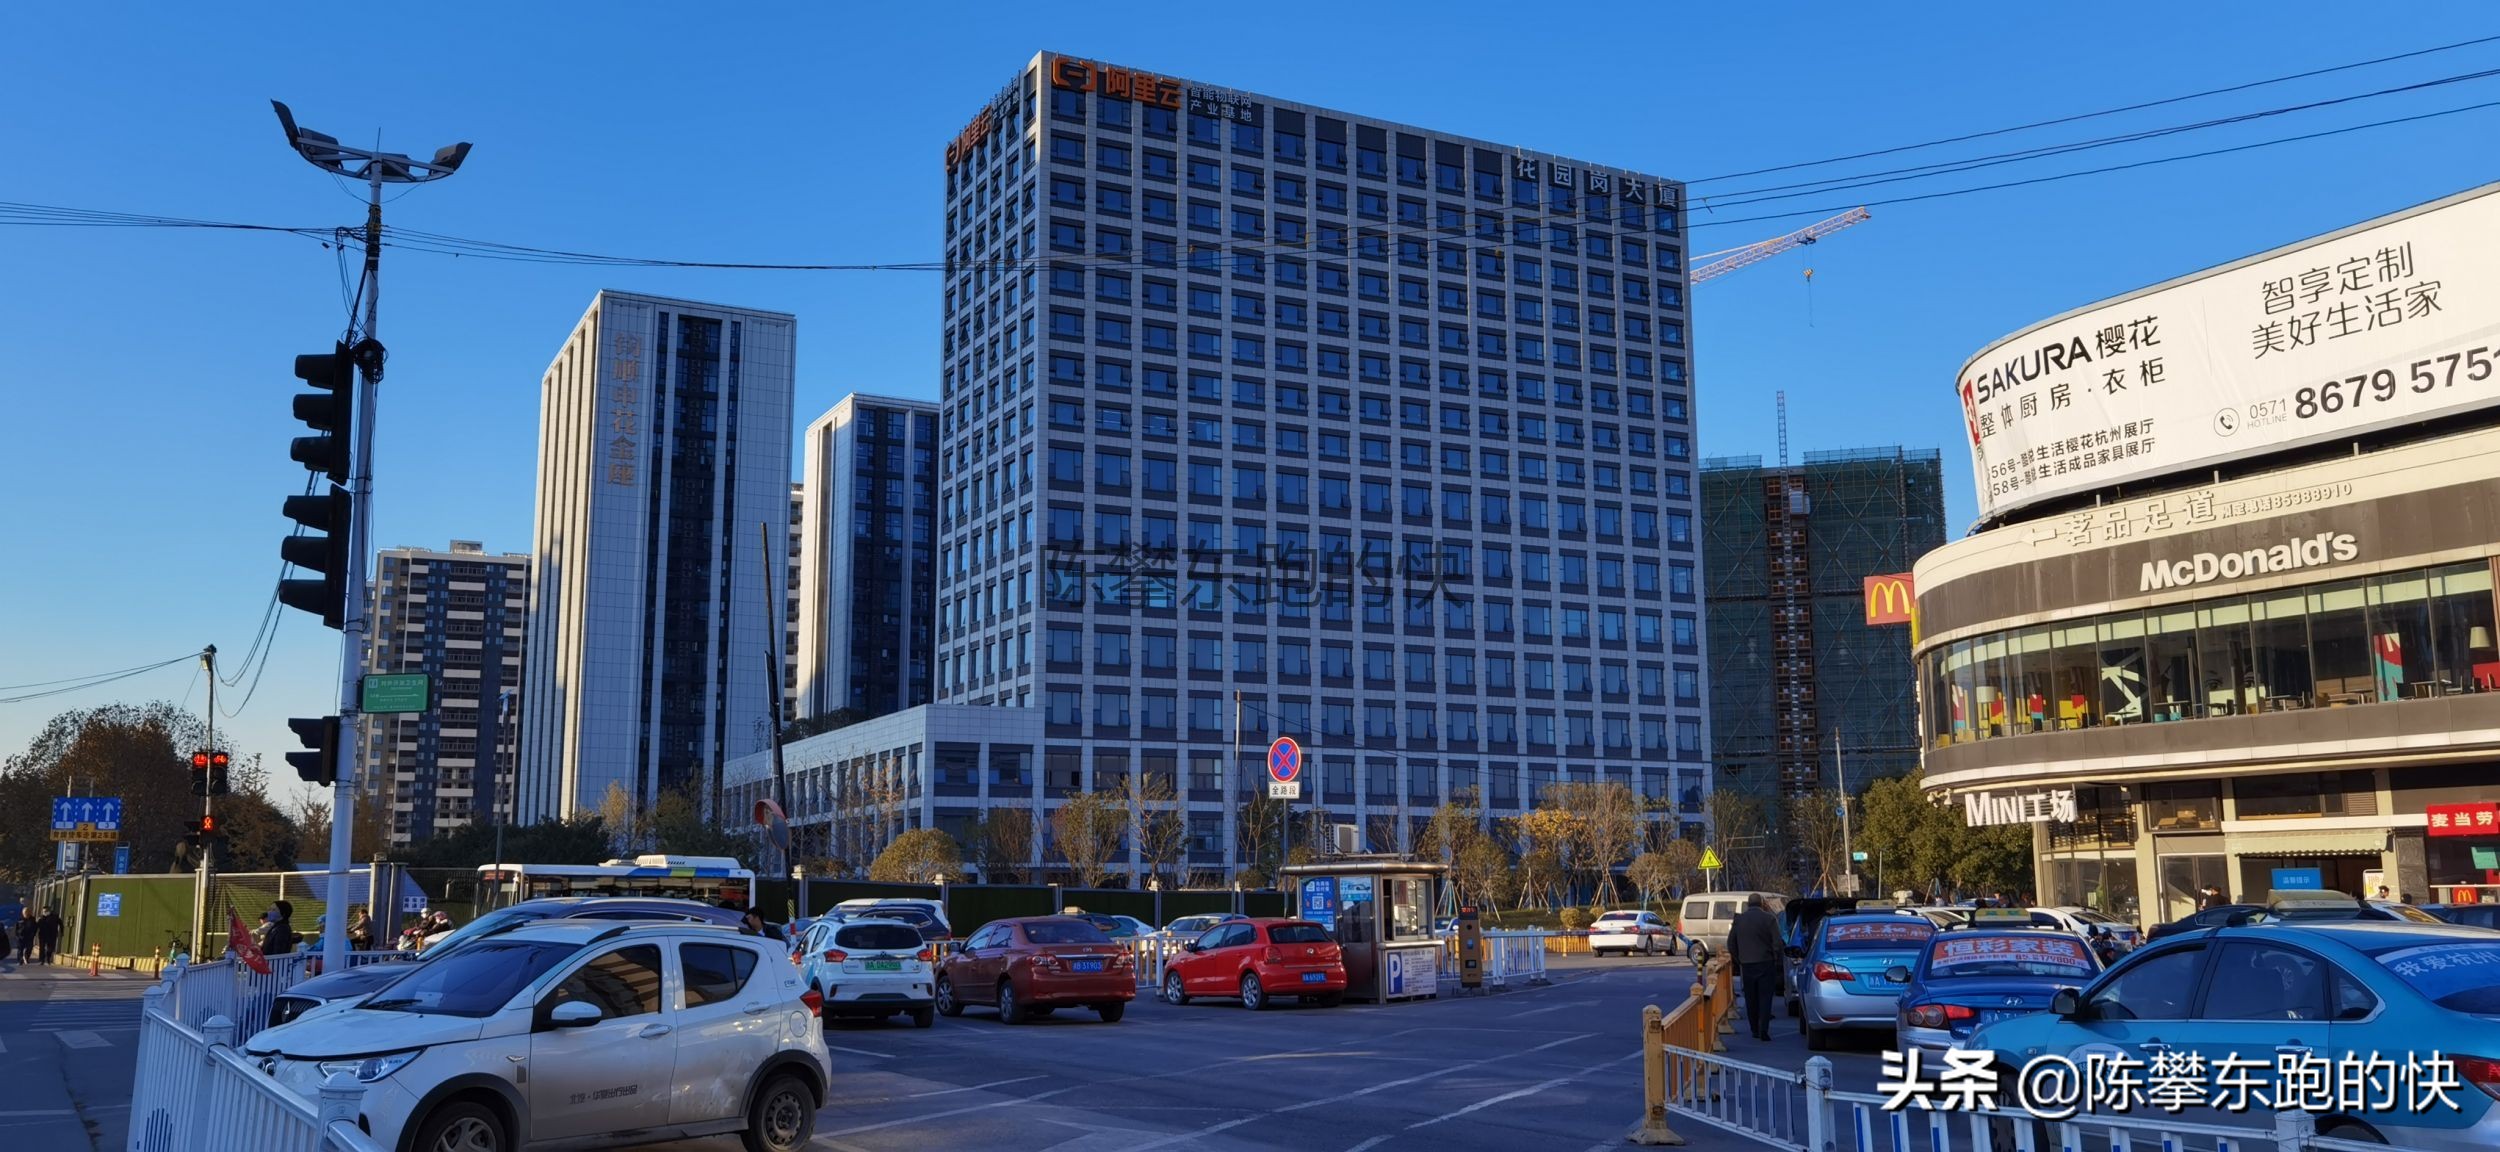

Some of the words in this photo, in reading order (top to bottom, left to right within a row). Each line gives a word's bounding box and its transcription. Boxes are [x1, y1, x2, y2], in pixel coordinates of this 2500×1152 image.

[1106, 66, 1181, 109] 阿里云
[1190, 86, 1251, 108] 智能物联网
[962, 105, 992, 150] 阿里云
[1190, 99, 1252, 122] 产业基地
[1517, 156, 1677, 207] 花园岗大厦
[2262, 241, 2414, 315] 智享定制
[2252, 280, 2442, 360] 美好生活家
[1977, 336, 2092, 405] SAKURA
[2096, 315, 2161, 360] 樱花
[2295, 368, 2396, 419] 8679
[2410, 346, 2500, 394] 575
[2247, 414, 2288, 430] HOTLINE
[2250, 398, 2287, 420] 0571
[2067, 490, 2217, 547] 茗品足道
[2140, 531, 2359, 592] McDonald's
[1272, 785, 1296, 795] 全路段
[2431, 811, 2494, 828] 麦当劳
[1944, 940, 2075, 957] 恒彩家装
[2394, 951, 2500, 977] 我爱杭州
[1390, 953, 1401, 993] P
